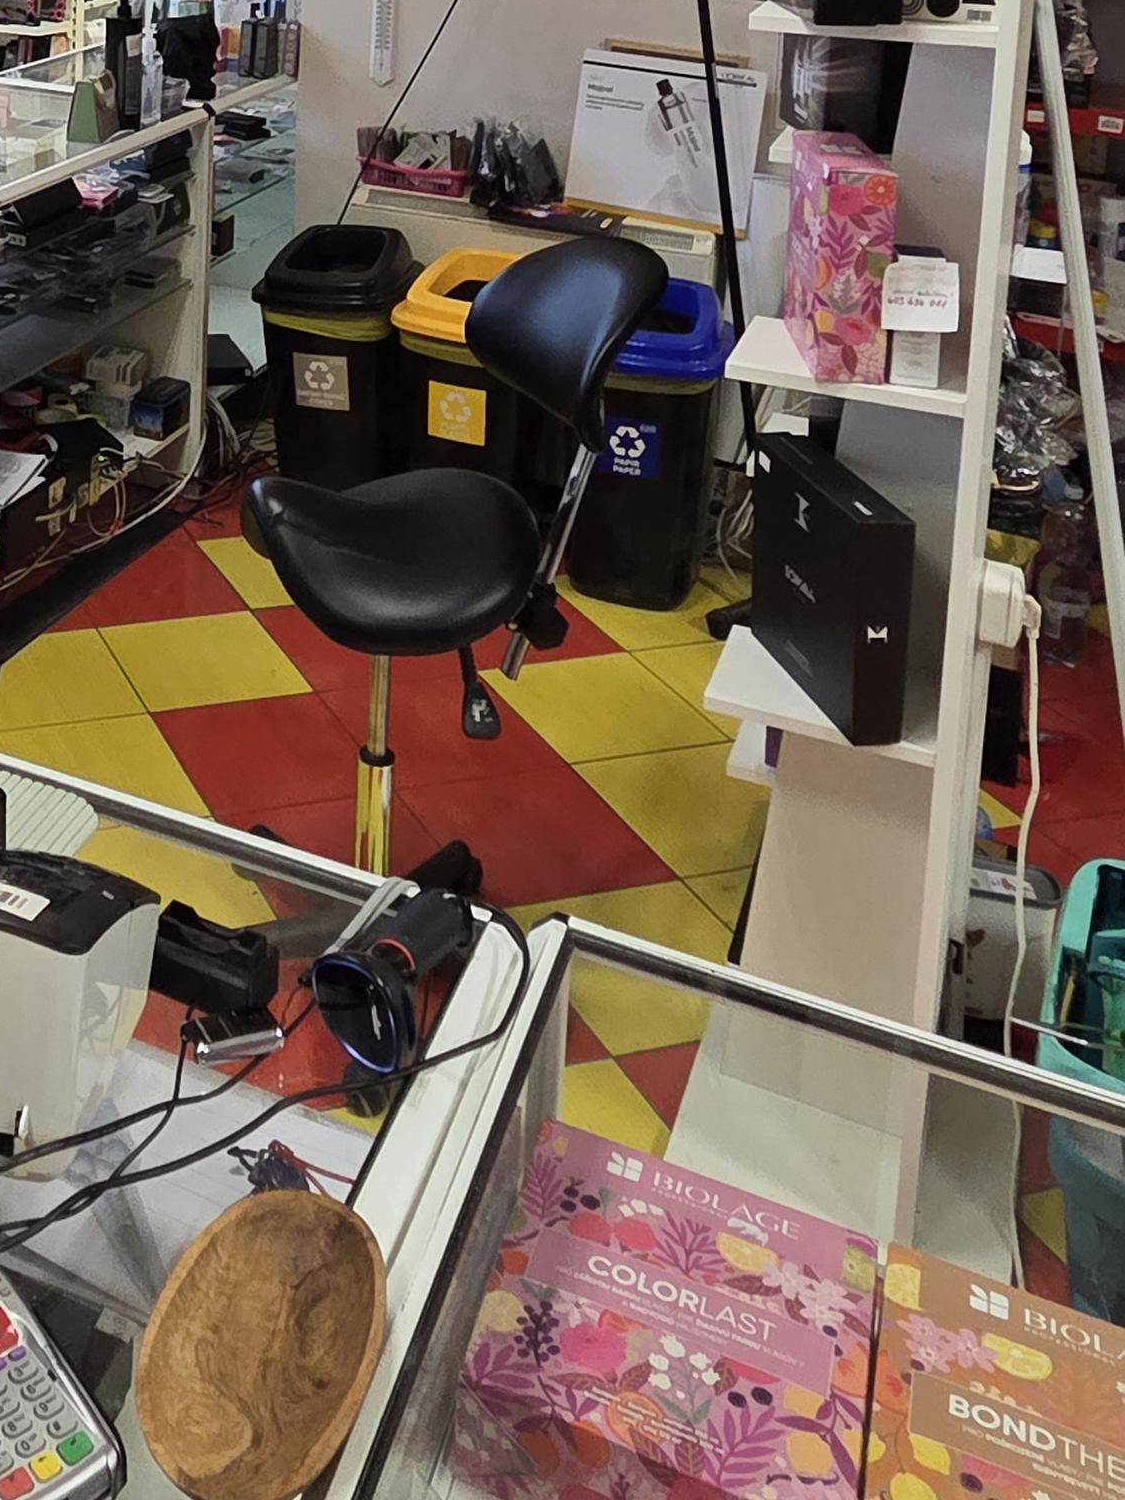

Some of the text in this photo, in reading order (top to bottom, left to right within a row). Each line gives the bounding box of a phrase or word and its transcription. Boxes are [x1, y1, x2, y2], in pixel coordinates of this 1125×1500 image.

[651, 1171, 802, 1241] BIOLAGE
[587, 1254, 778, 1342] COLORLAST
[1024, 1308, 1125, 1360] BIOL
